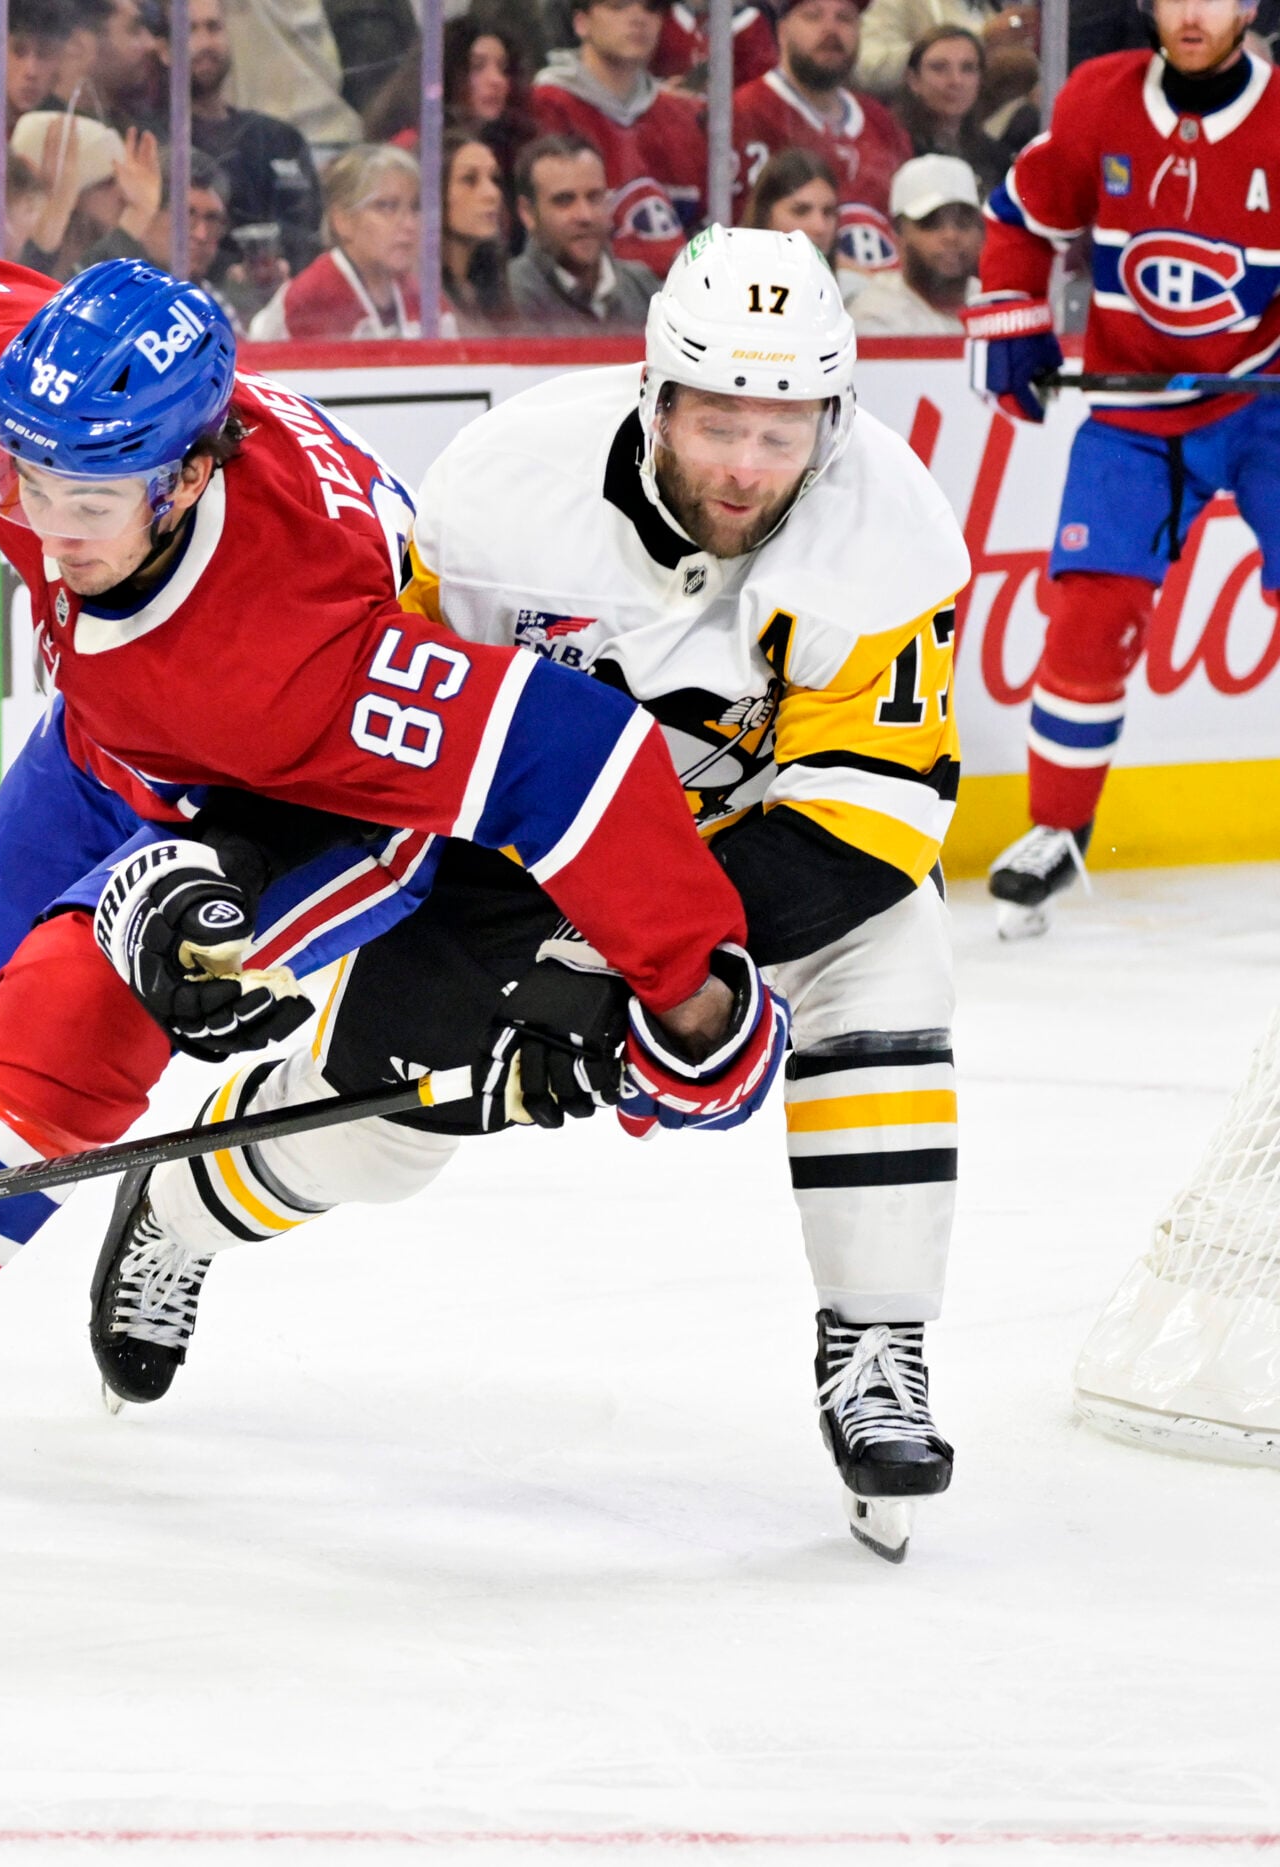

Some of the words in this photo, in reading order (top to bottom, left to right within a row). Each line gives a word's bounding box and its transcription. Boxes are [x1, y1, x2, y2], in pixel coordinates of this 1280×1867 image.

[1246, 168, 1270, 213] A
[748, 284, 790, 315] 17
[133, 299, 206, 375] Bell
[30, 361, 78, 405] 85
[350, 627, 471, 769] 85
[98, 845, 177, 961] RRIOR
